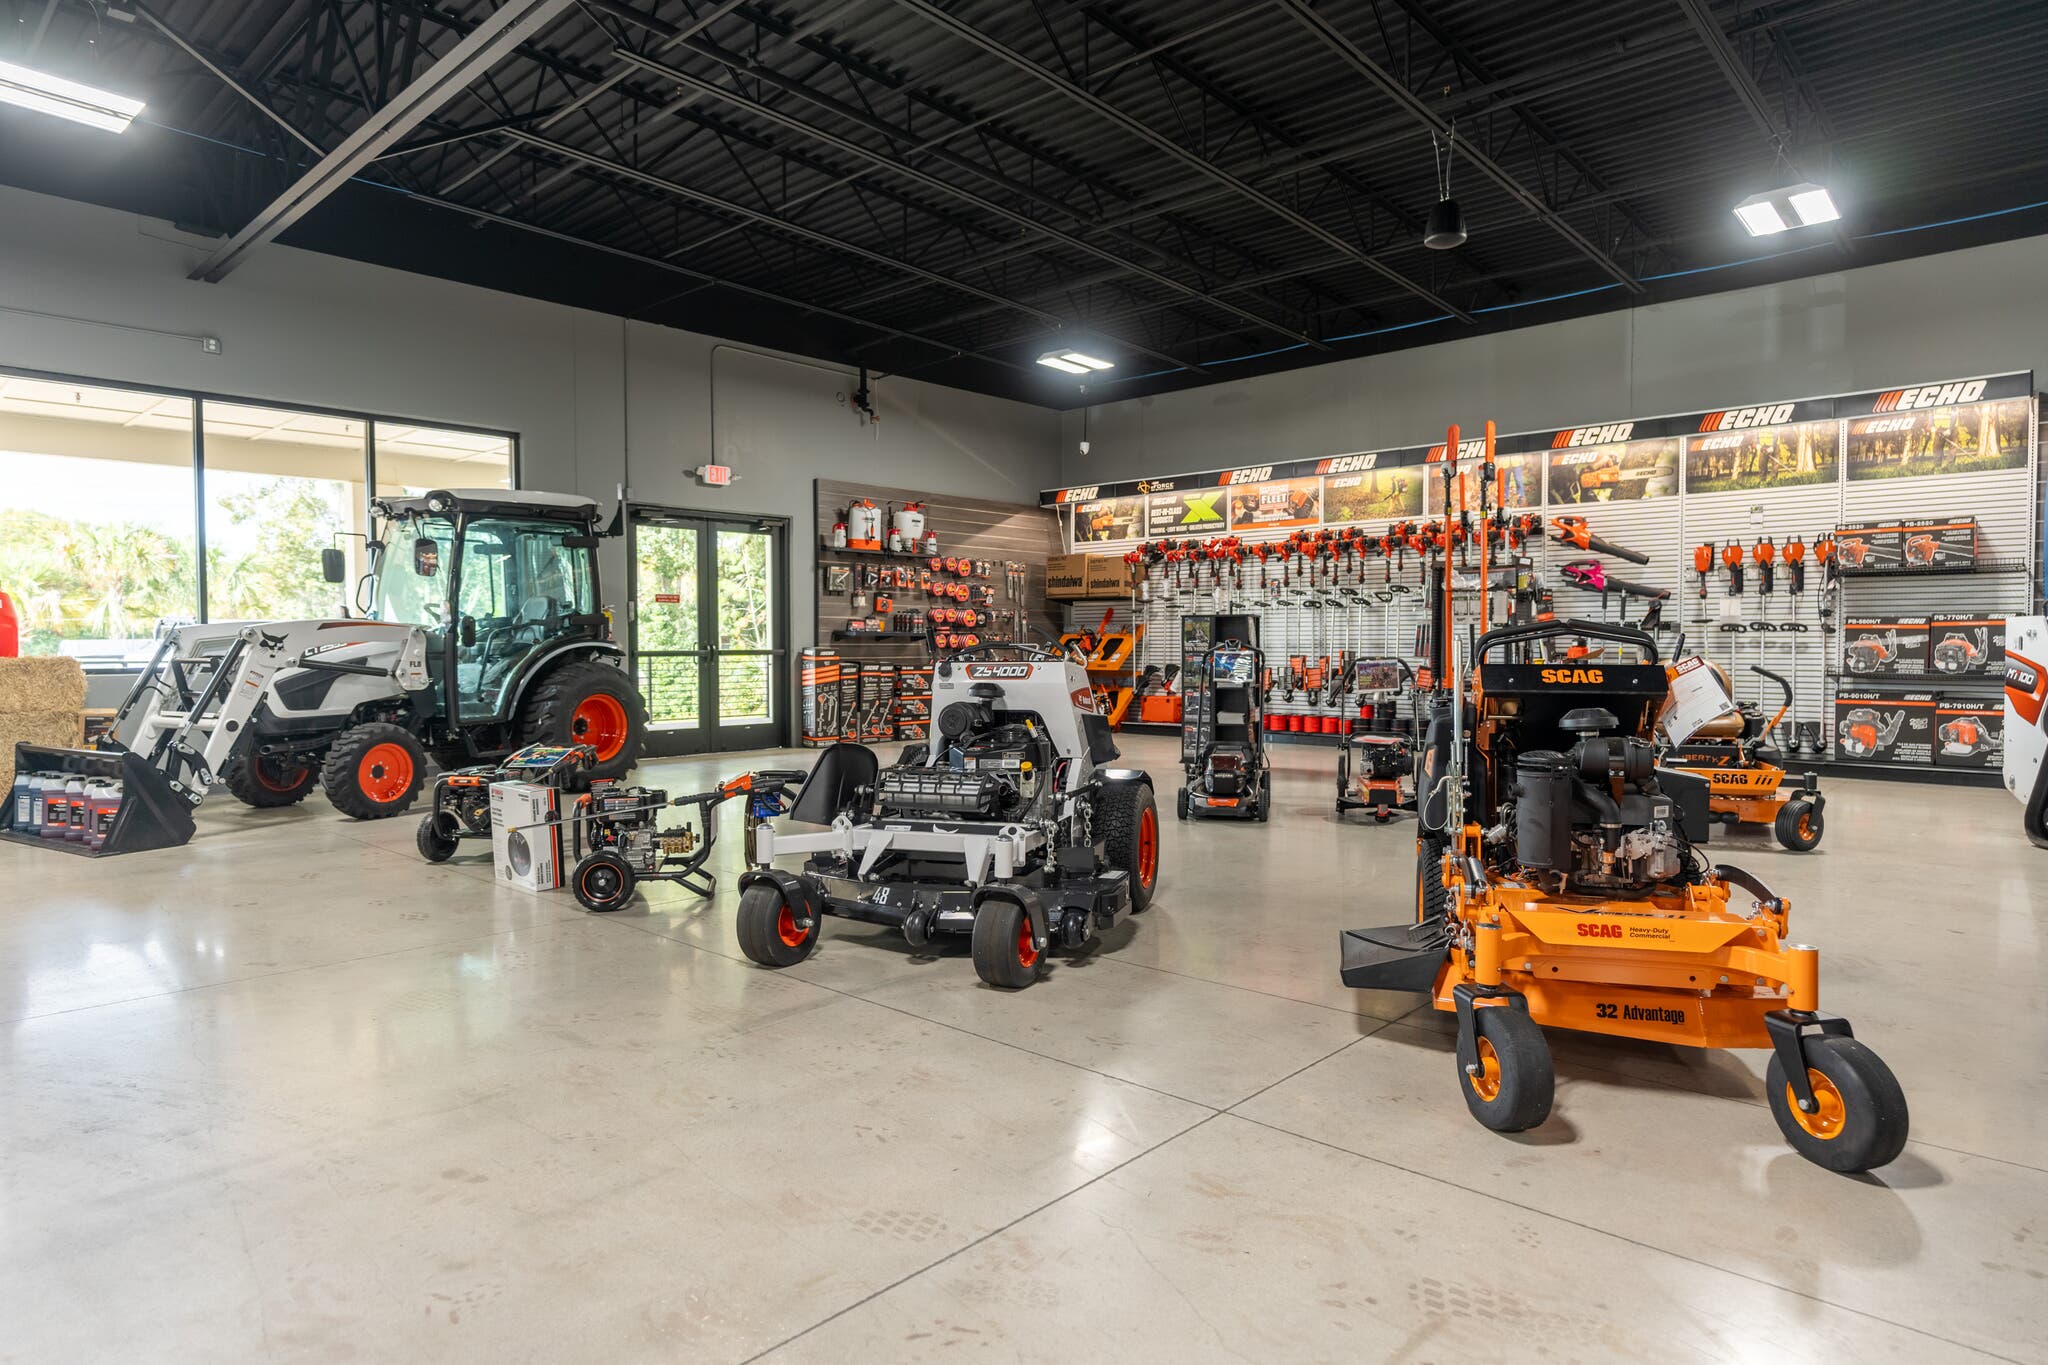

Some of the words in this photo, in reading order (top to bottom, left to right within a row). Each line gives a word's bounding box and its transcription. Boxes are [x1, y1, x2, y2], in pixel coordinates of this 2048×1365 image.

[1894, 380, 1988, 411] ECHO
[1718, 403, 1796, 431] ECHO
[1866, 417, 1917, 433] ECHO
[1567, 422, 1634, 447] ECHO
[1700, 435, 1745, 451] ECHO
[1328, 453, 1377, 473] ECHO
[1561, 451, 1599, 466] ECHO
[1229, 466, 1273, 485] ECHO
[1333, 476, 1362, 488] ECHO
[1064, 486, 1100, 502] ECHO
[1081, 503, 1102, 513] ECHO
[1047, 575, 1083, 588] shindaiwa
[1676, 656, 1701, 674] SCAG
[1541, 669, 1604, 684] SCAG
[1712, 773, 1749, 785] SCAG
[872, 886, 890, 905] 48
[1576, 922, 1623, 939] SCAG
[1629, 926, 1669, 935] Heavy-Duty
[1629, 931, 1671, 940] Commercial
[1595, 1003, 1618, 1019] 32
[1623, 1004, 1685, 1025] Advantage
